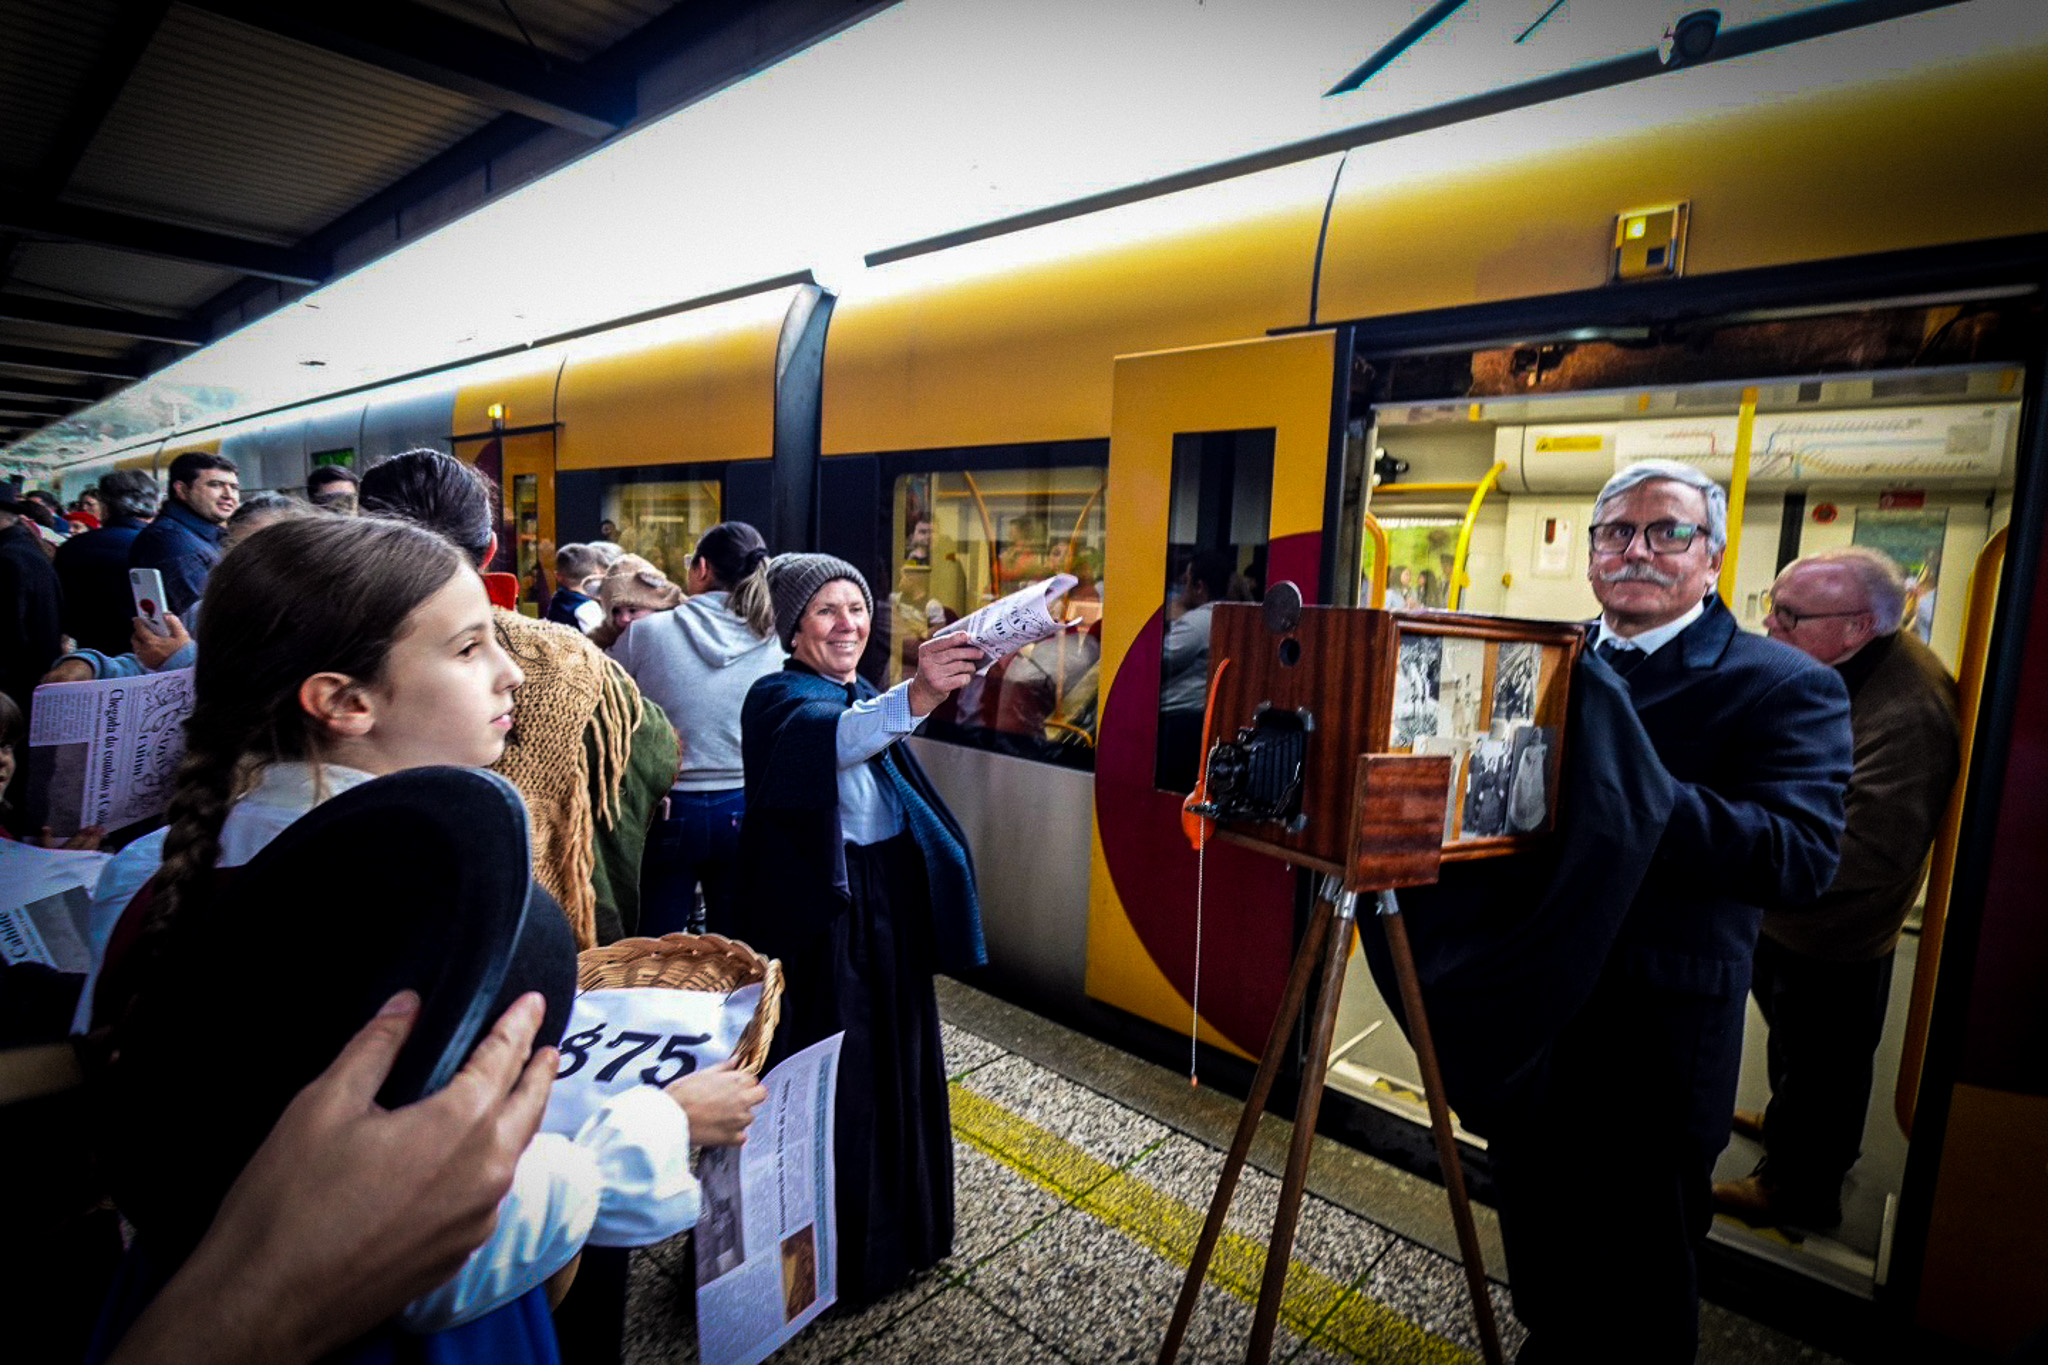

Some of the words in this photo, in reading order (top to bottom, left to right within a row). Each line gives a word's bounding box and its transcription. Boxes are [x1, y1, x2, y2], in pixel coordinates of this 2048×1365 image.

[104, 689, 124, 733] Chegada
[104, 736, 120, 748] do
[100, 750, 116, 791] comboio
